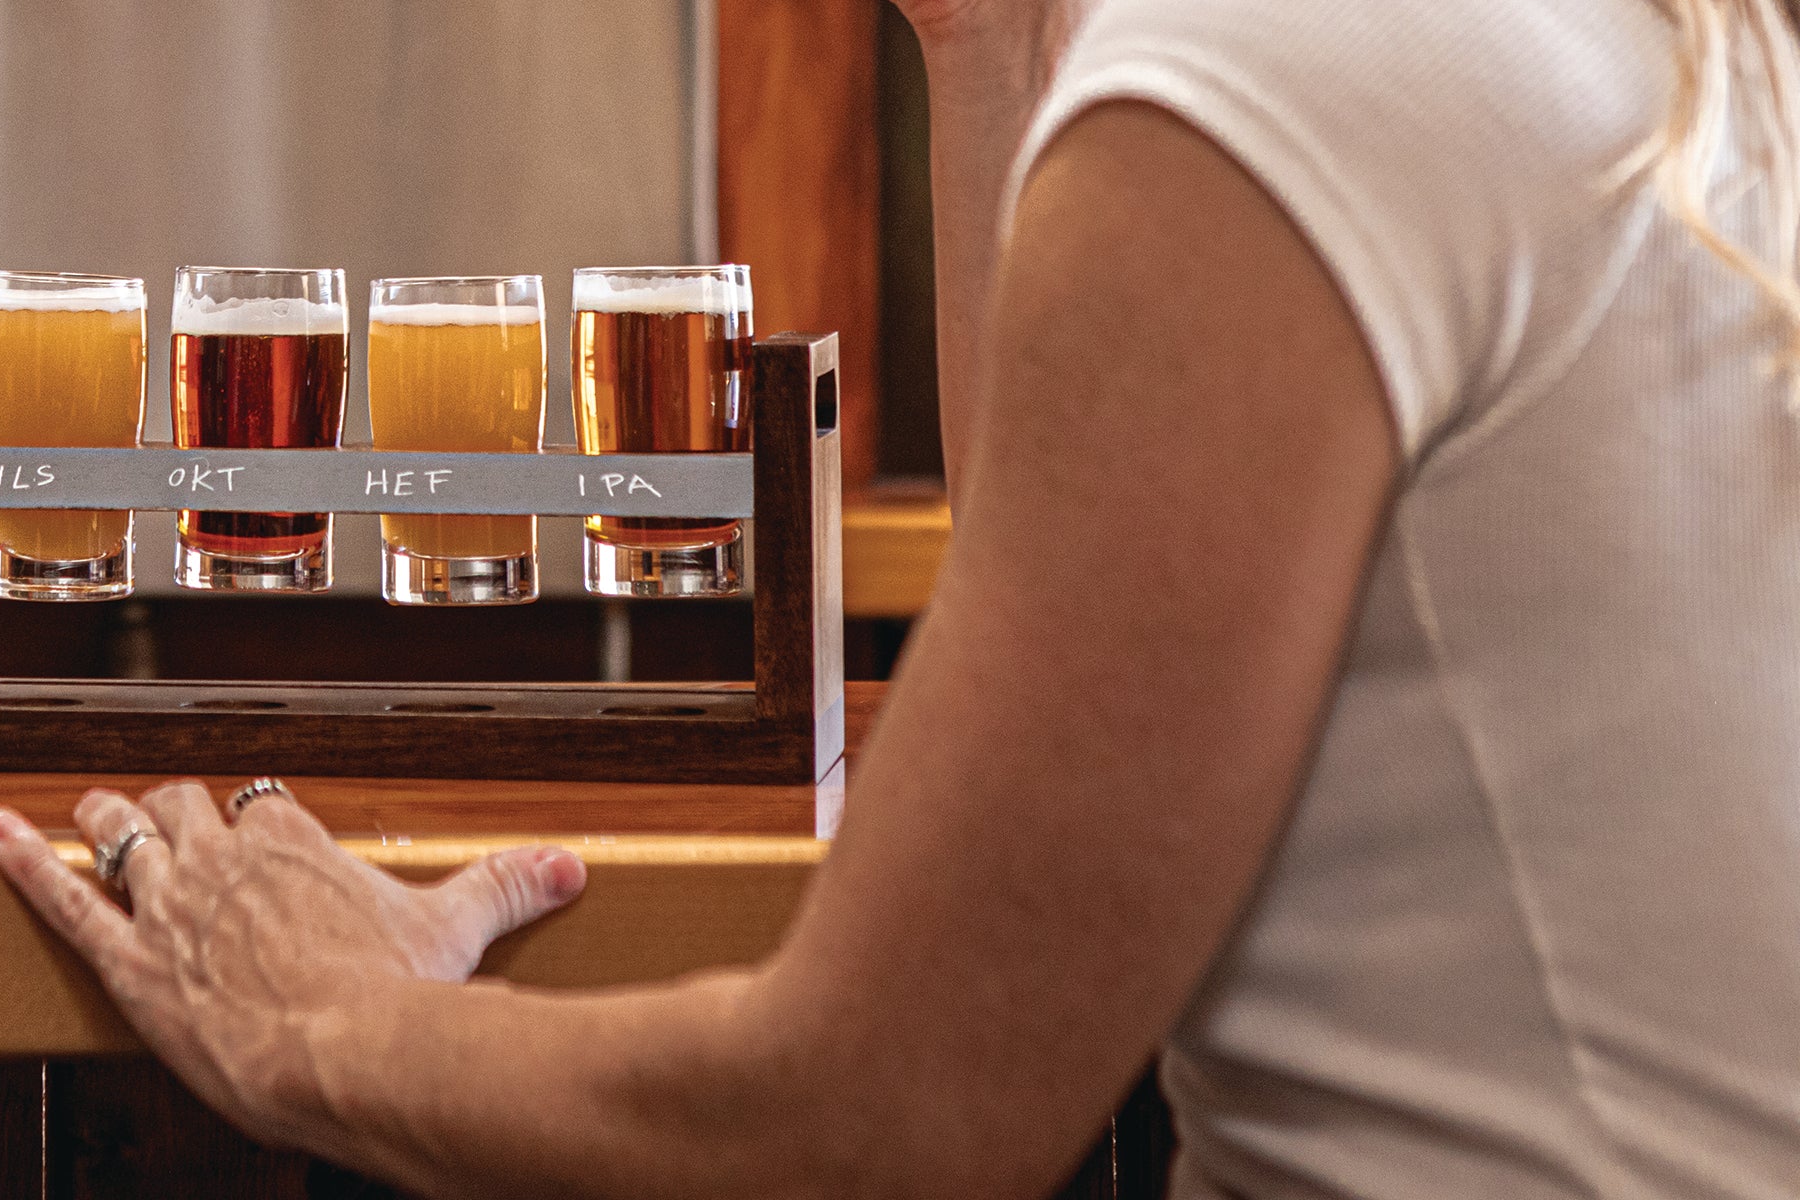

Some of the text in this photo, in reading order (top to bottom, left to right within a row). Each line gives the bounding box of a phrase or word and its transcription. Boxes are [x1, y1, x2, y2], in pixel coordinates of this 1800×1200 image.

[167, 463, 247, 492] OKT
[364, 468, 454, 497] HEF
[577, 473, 663, 499] IPA
